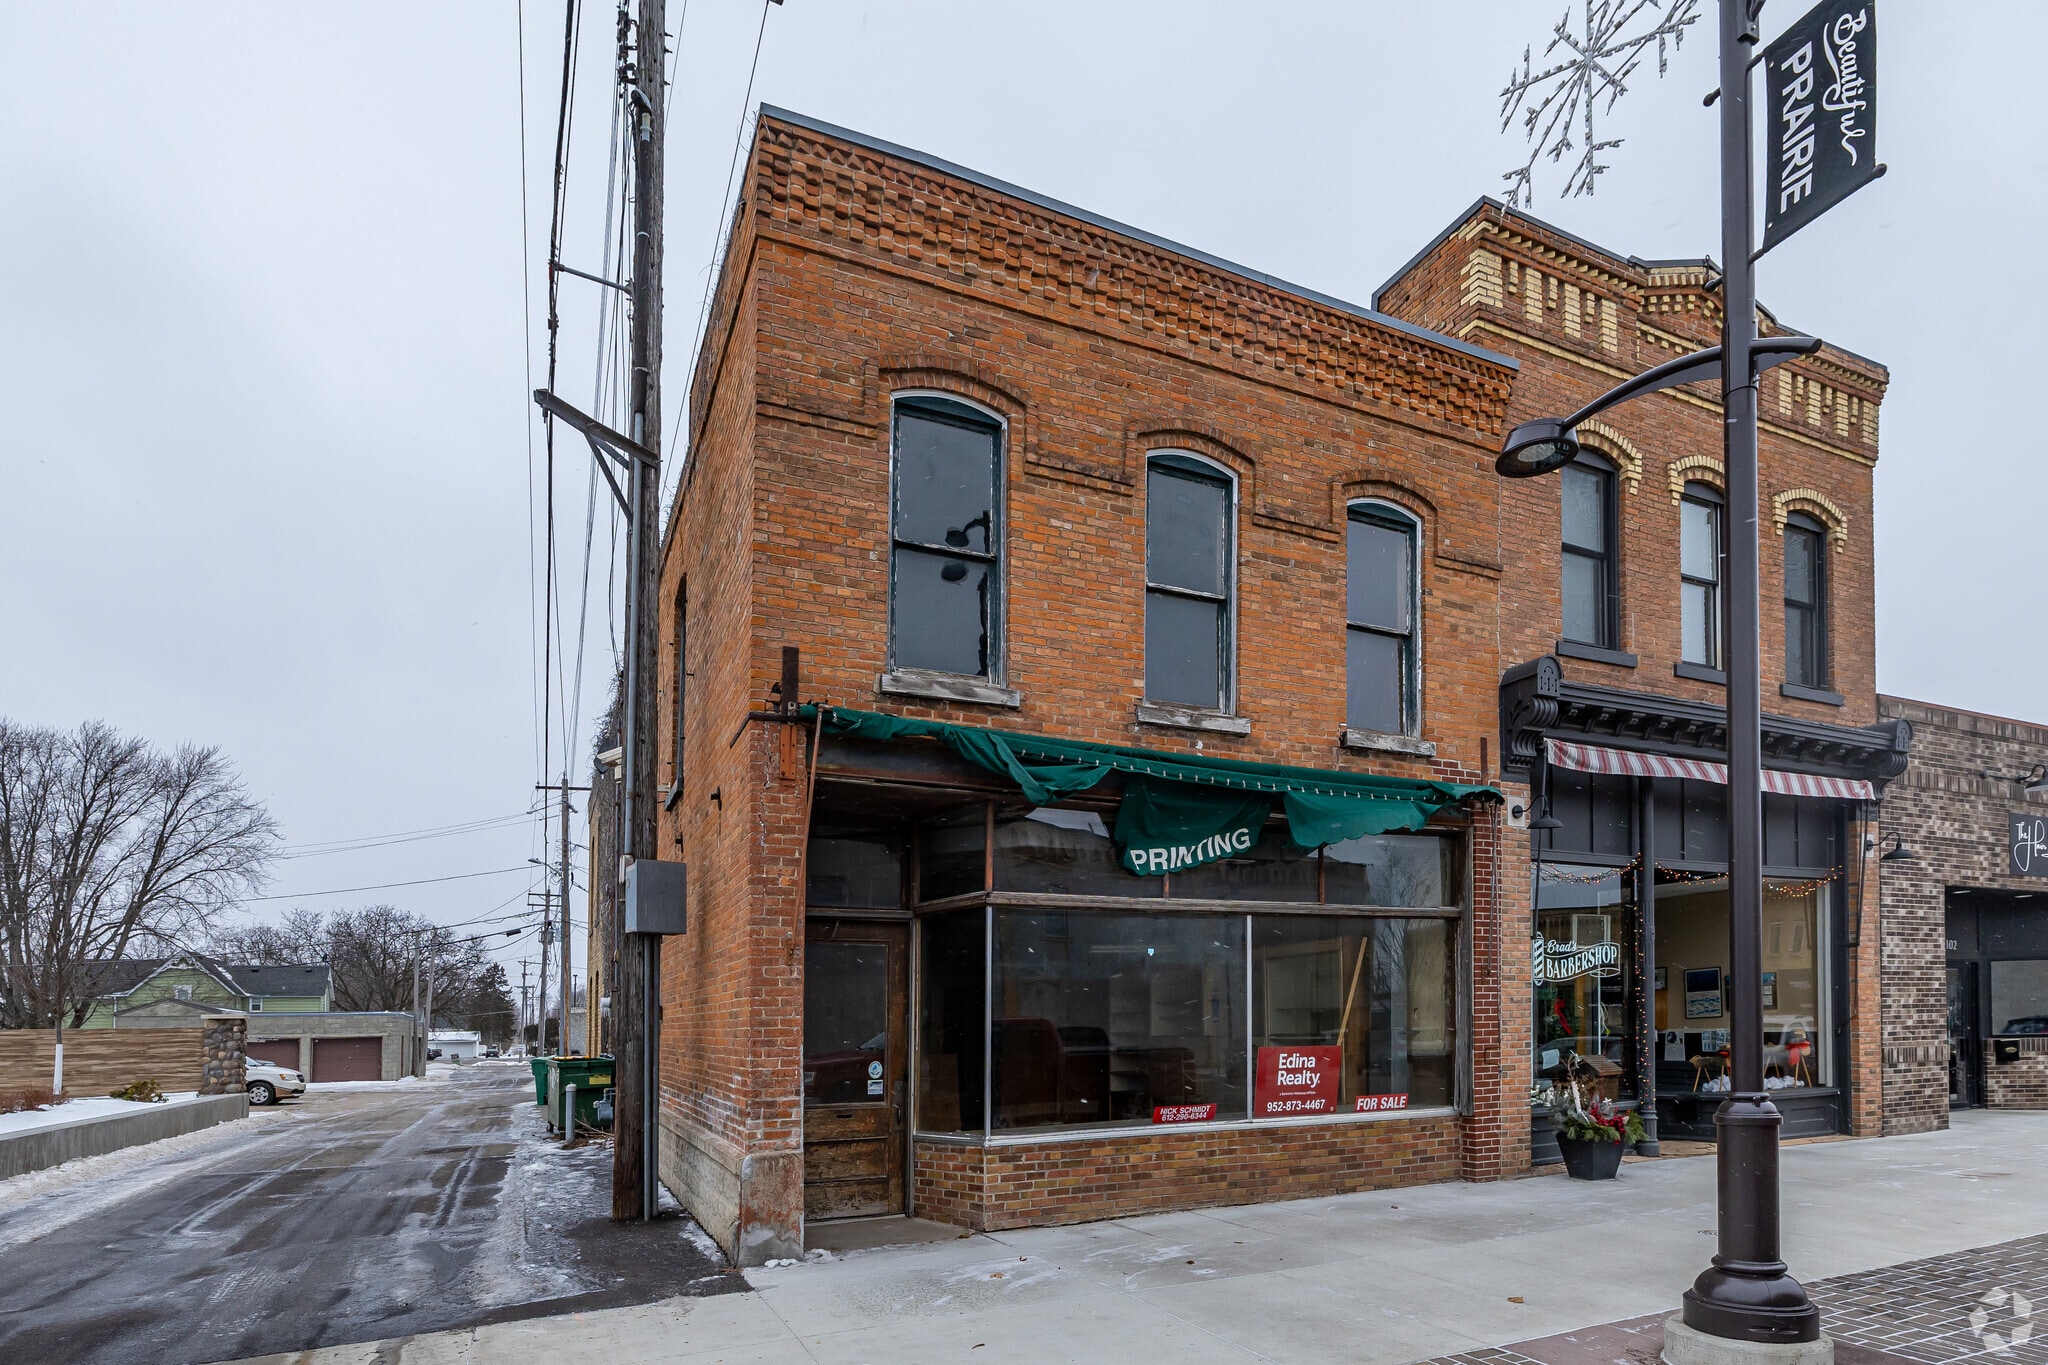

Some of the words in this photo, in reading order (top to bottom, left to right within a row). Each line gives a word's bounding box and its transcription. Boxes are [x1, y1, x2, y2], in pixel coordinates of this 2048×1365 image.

[1822, 8, 1867, 167] Beautiful
[1780, 40, 1815, 214] PRAIRIE
[1130, 827, 1251, 871] PRINTING
[1546, 939, 1578, 954] Brad's
[1546, 945, 1617, 978] BARBERSHOP
[1278, 1053, 1316, 1069] Edina
[1160, 1107, 1178, 1115] NICK
[1179, 1105, 1211, 1114] SCHMIDT
[1266, 1099, 1326, 1112] 952-873-4467
[1356, 1097, 1378, 1111] FOR
[1380, 1096, 1407, 1110] SALE
